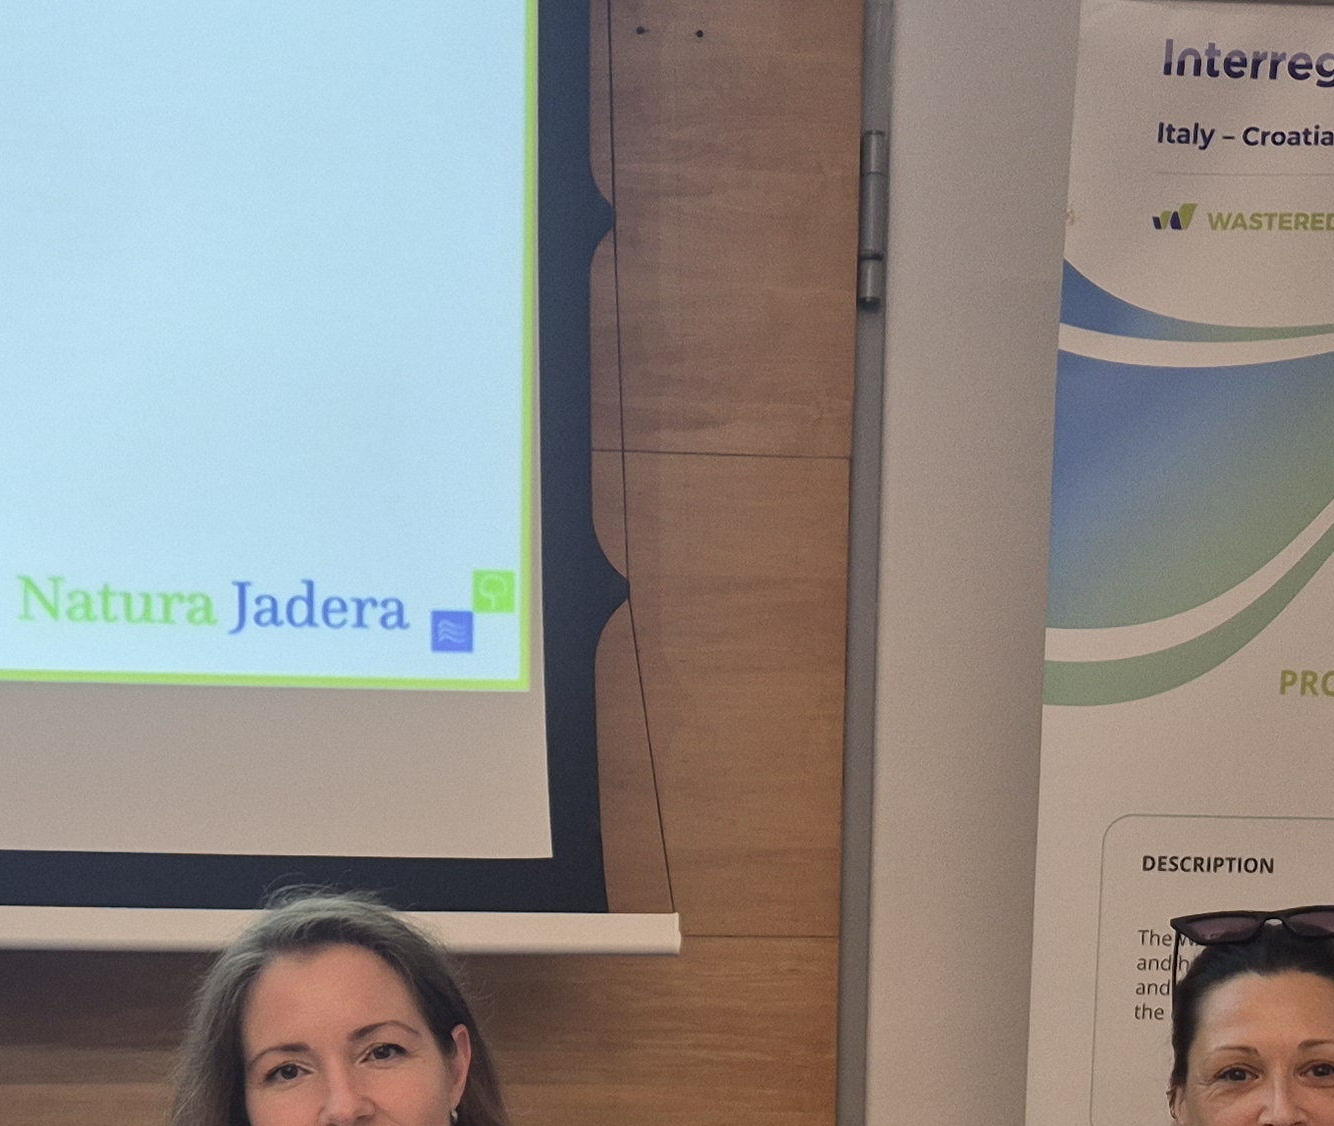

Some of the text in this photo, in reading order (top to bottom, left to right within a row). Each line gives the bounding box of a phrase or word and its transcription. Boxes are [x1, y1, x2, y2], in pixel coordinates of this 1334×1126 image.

[1157, 122, 1215, 150] Italy
[1242, 125, 1334, 147] Croatia
[17, 575, 410, 634] Natura Jadera
[1141, 855, 1275, 874] DESCRIPTION
[1138, 929, 1172, 947] The
[1136, 955, 1172, 972] and
[1135, 980, 1171, 997] and
[1134, 1004, 1165, 1021] the
